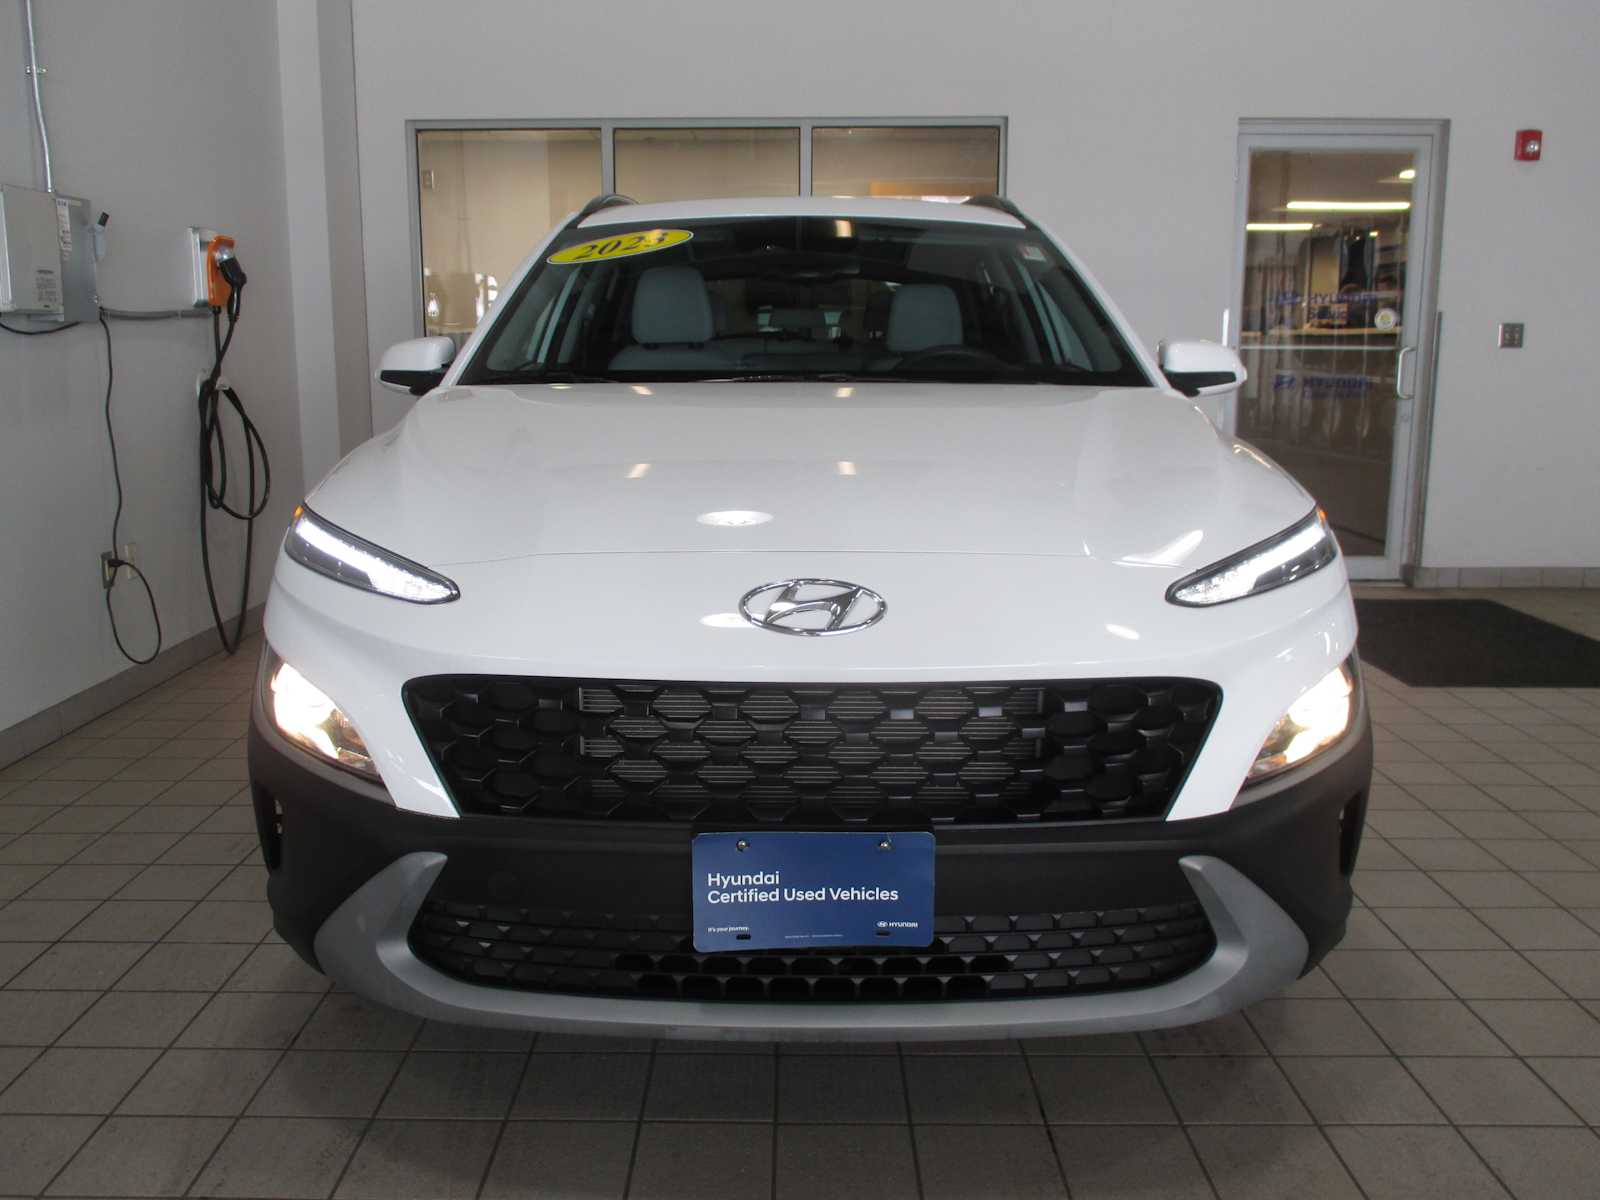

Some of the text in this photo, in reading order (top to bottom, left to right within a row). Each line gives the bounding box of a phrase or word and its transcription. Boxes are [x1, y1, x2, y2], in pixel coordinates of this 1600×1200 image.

[707, 871, 780, 889] Hyundai
[707, 887, 899, 904] Certified Used Vehicles
